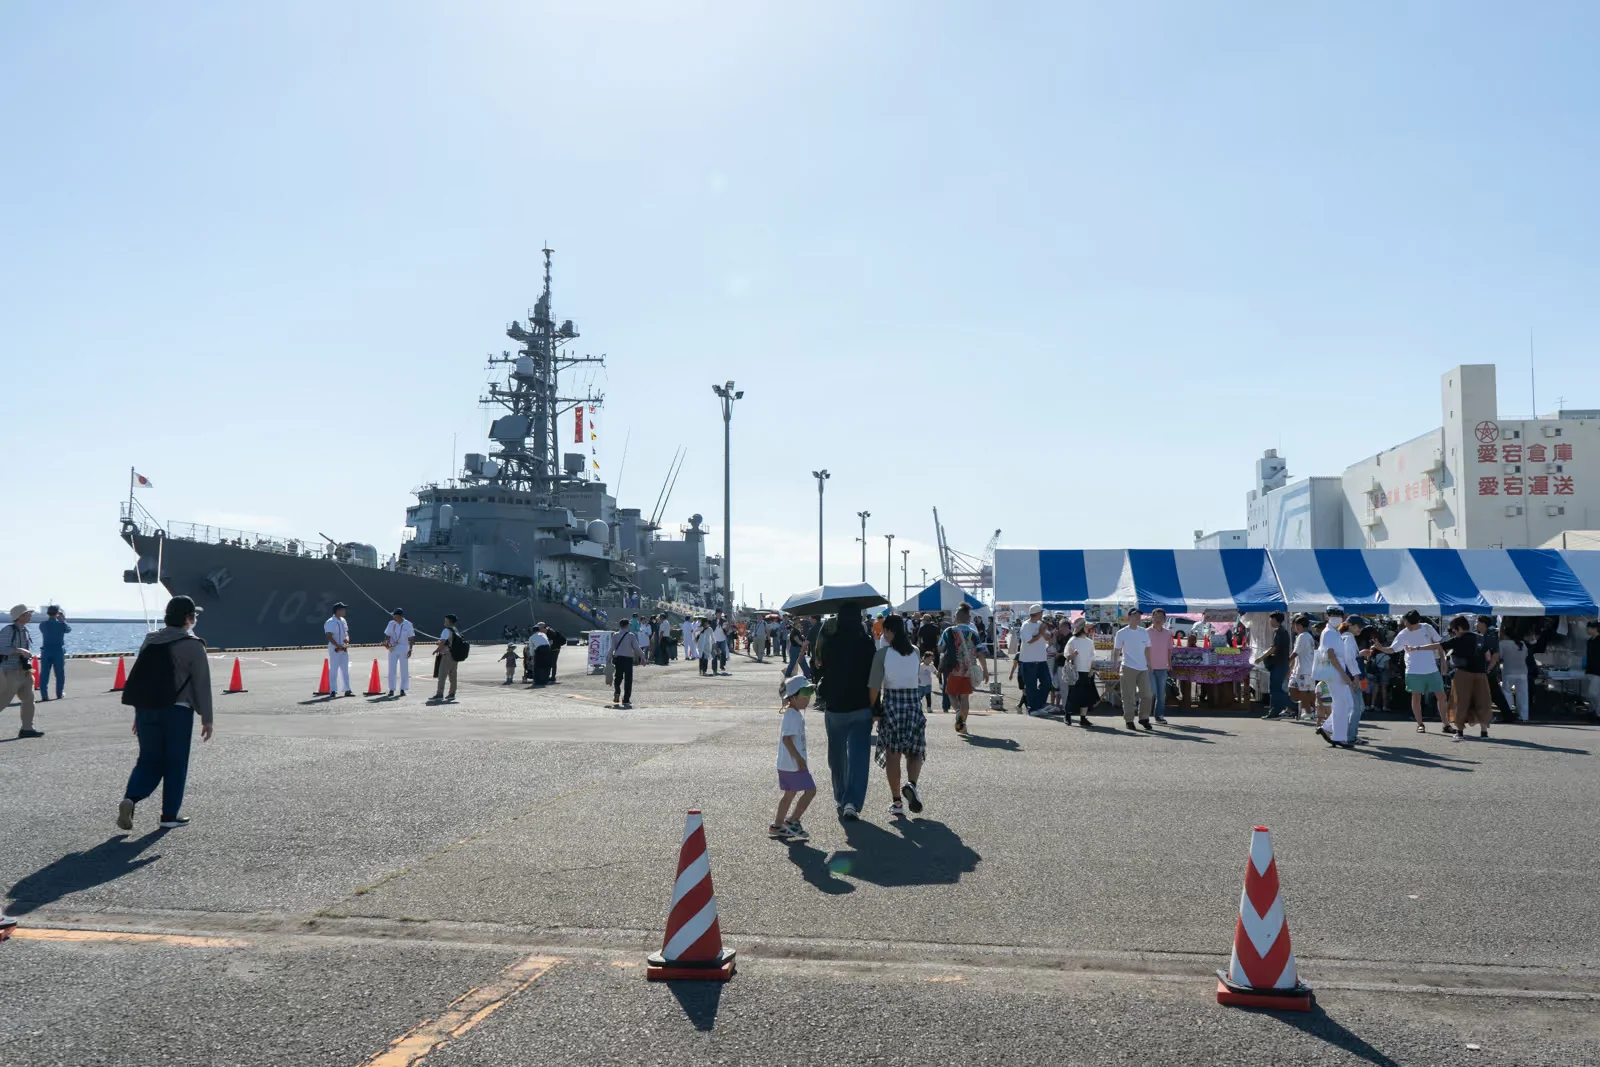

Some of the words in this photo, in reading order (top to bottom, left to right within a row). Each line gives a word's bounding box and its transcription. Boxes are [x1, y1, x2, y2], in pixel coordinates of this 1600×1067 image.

[1477, 443, 1573, 463] 愛宕倉庫
[1478, 475, 1575, 496] 愛宕運送
[257, 589, 336, 624] 103
